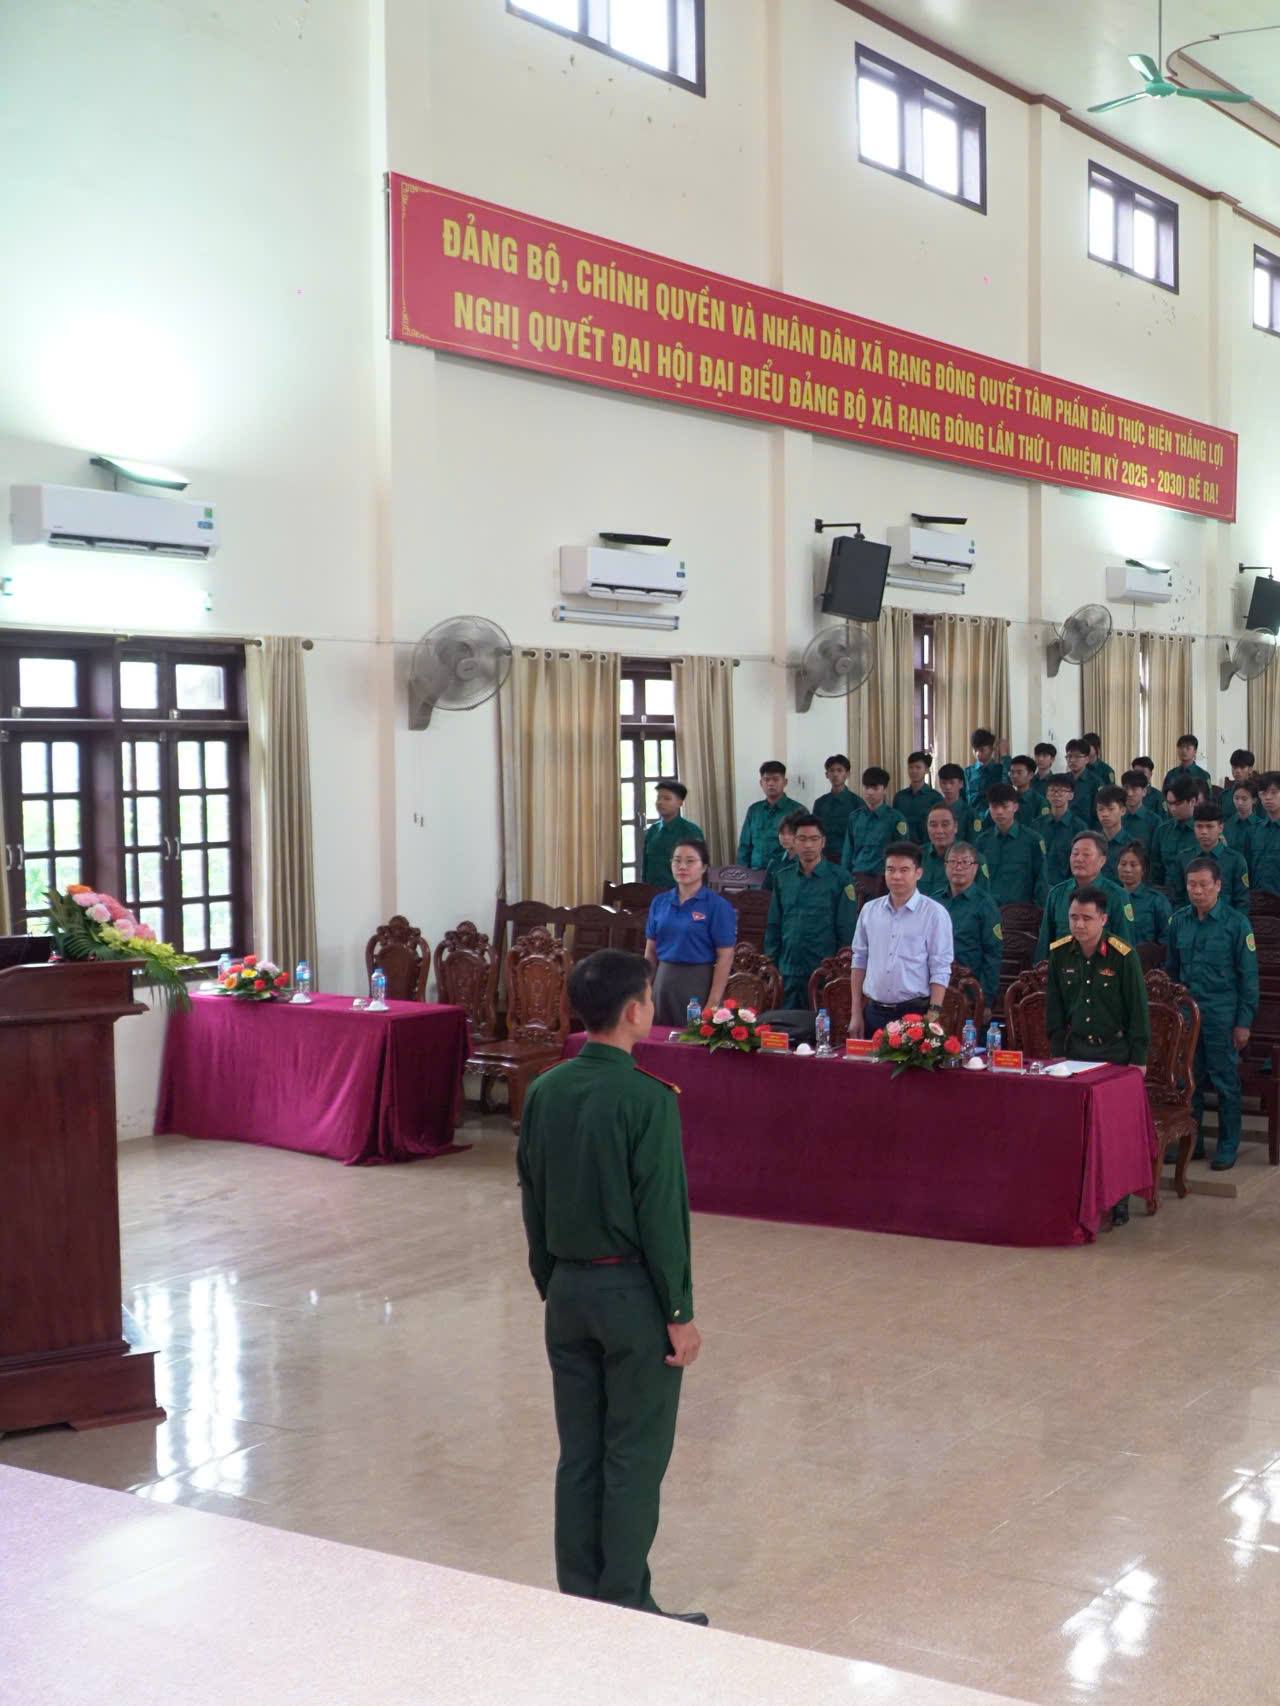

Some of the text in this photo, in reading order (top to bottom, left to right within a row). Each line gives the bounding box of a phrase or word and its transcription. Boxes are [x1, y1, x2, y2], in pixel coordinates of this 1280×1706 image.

[442, 213, 518, 274] ĐẢNG
[527, 242, 568, 293] BỘ,
[576, 260, 648, 312] CHÍNH
[731, 302, 757, 341] VÀ
[762, 314, 815, 356] NHÂN
[820, 328, 856, 367] DÂN
[861, 339, 883, 374] XÃ
[888, 349, 931, 388] RẠNG
[935, 361, 976, 398] ĐÔNG
[979, 376, 1021, 411] QUYẾT
[1025, 387, 1052, 420] TÂM
[1056, 395, 1088, 430] PHẤN
[1092, 404, 1115, 437] ĐẤU
[1118, 416, 1145, 448] THỰC
[1148, 424, 1172, 456] HIỆN
[1209, 443, 1223, 470] LỢI
[454, 291, 520, 350] NGHỊ
[528, 311, 605, 362] QUYẾT
[612, 332, 650, 378] ĐẠI
[658, 342, 693, 388] HỘI
[700, 355, 734, 397] ĐẠI
[740, 359, 784, 404] BIỂU
[789, 371, 839, 417] ĐẢNG
[844, 388, 866, 429] BỘ
[872, 395, 893, 429] XÃ
[898, 405, 940, 440] RẠNG
[945, 413, 984, 450] ĐÔNG
[1057, 445, 1101, 480] (NHIỆM
[1121, 461, 1149, 488] 2025
[1157, 469, 1186, 500] 2030)
[1203, 481, 1219, 504] RA!
